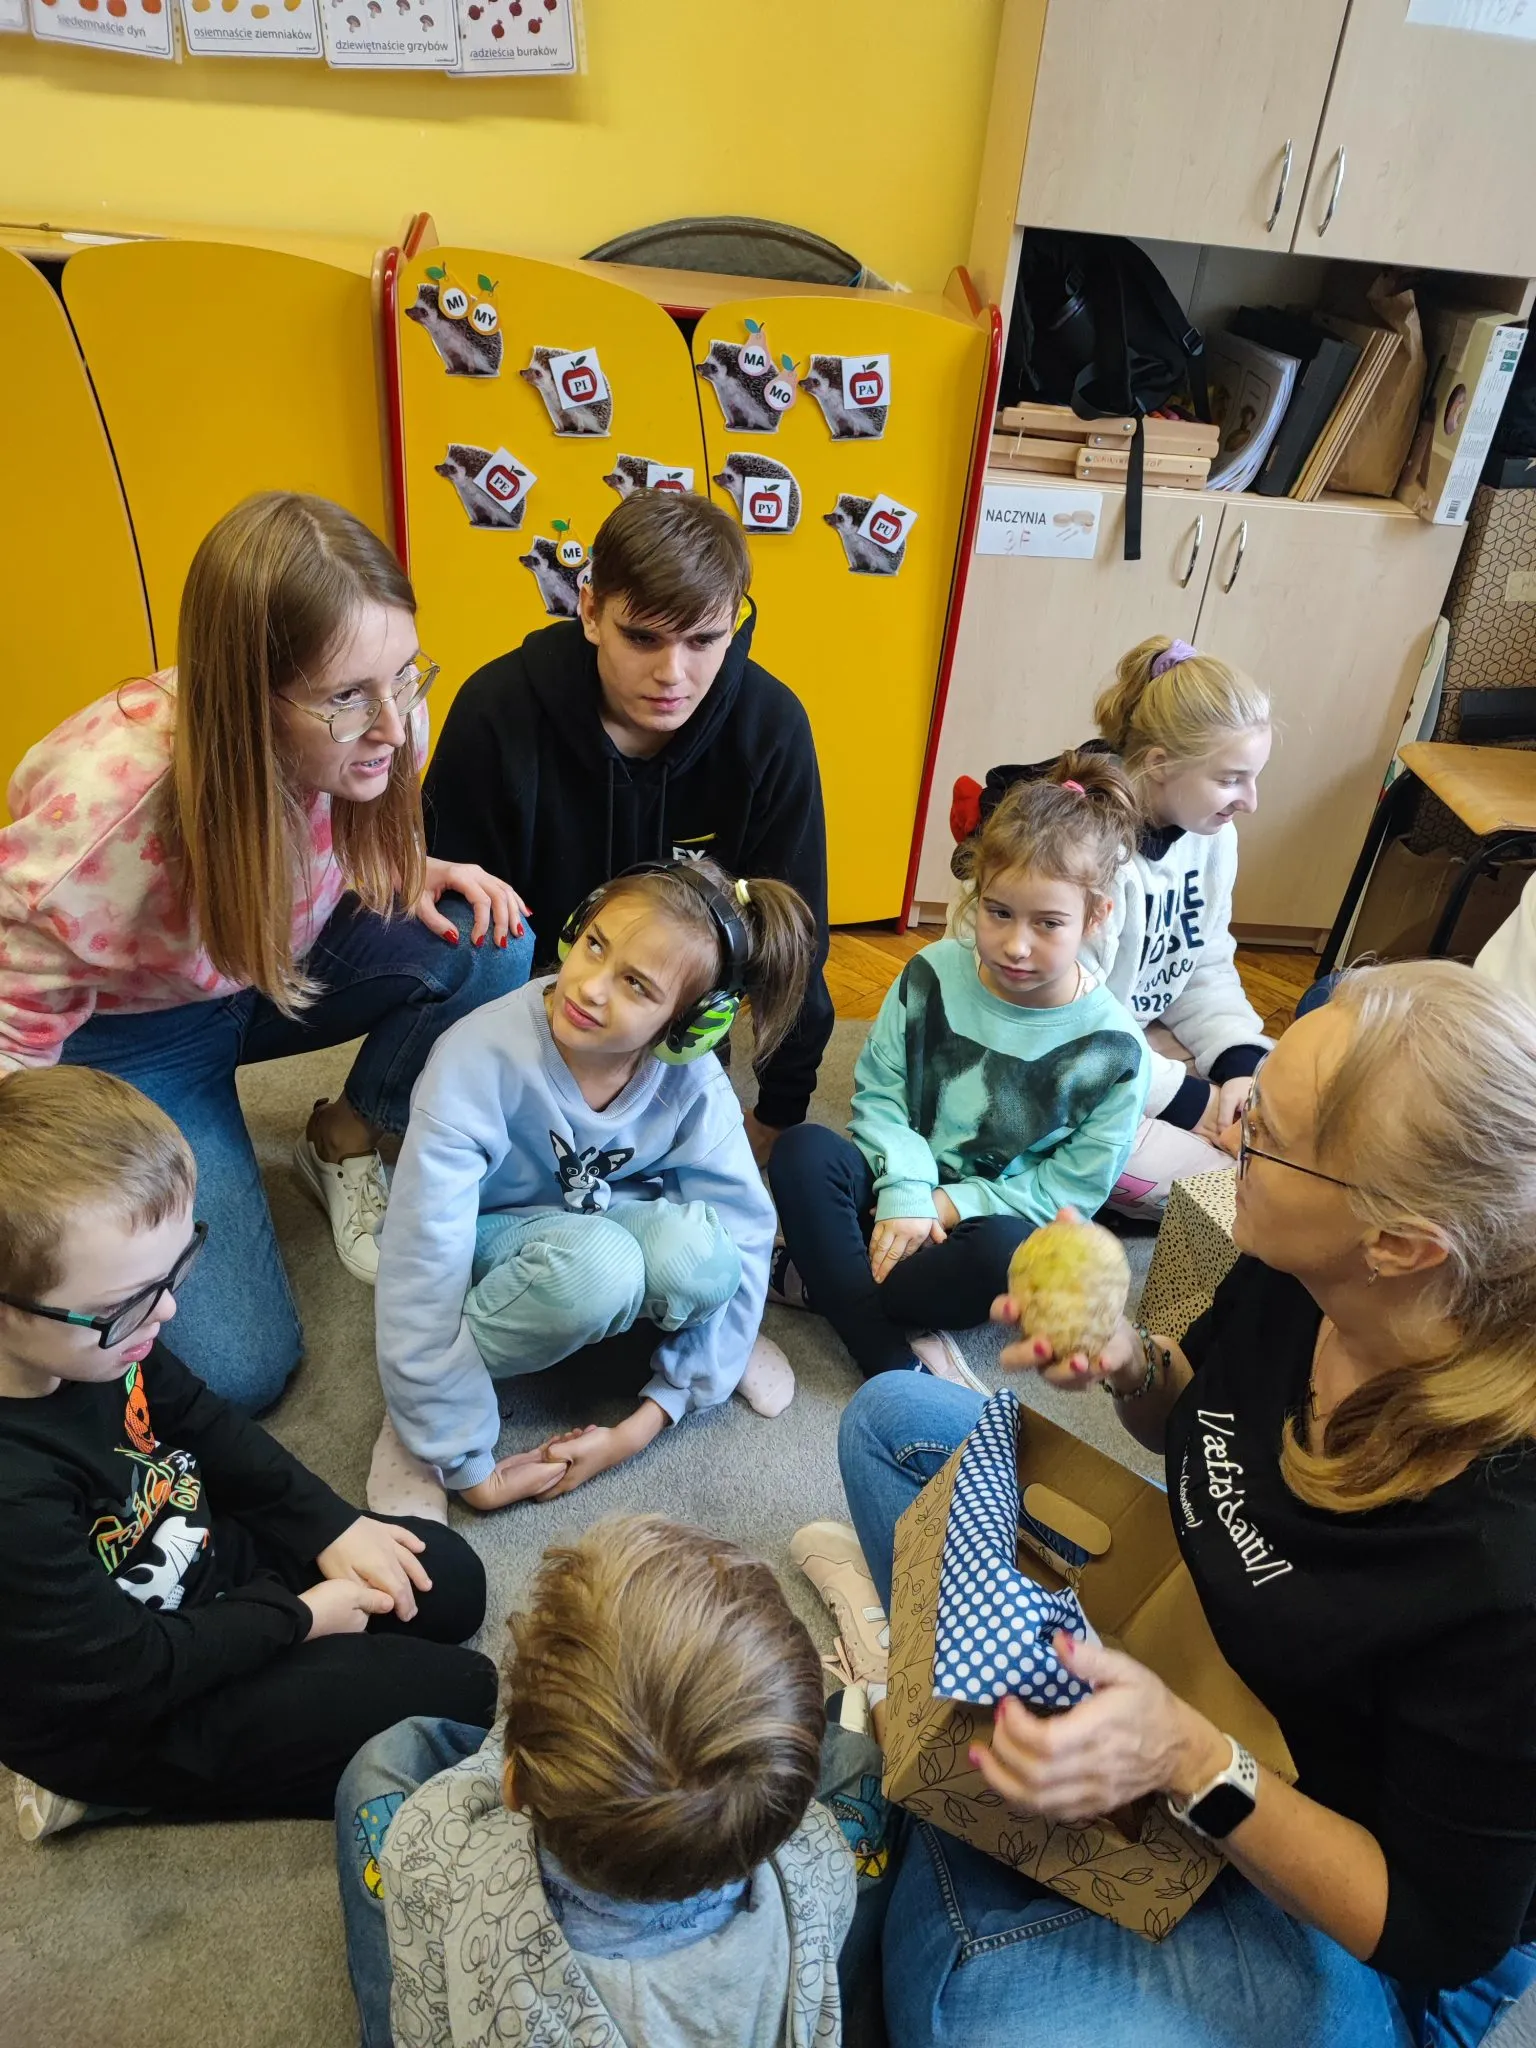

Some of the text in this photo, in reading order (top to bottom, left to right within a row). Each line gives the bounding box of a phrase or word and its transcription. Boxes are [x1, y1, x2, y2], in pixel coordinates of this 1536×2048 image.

[57, 14, 146, 38] siedemnaście dyń
[194, 27, 312, 39] osiemnaście ziemniaków
[335, 40, 448, 53] dziewiętnaście grzybów
[470, 46, 558, 58] adzieścia buraków
[446, 295, 465, 310] MI
[474, 309, 496, 326] MY
[743, 352, 765, 367] MA
[574, 379, 588, 392] PI
[858, 385, 875, 396] PA
[769, 384, 791, 404] MO
[493, 476, 510, 493] PE
[757, 503, 774, 514] PY
[985, 509, 1047, 525] NACZYNIA
[876, 522, 893, 537] PU
[563, 547, 581, 559] ME
[1131, 992, 1172, 1012] 1928
